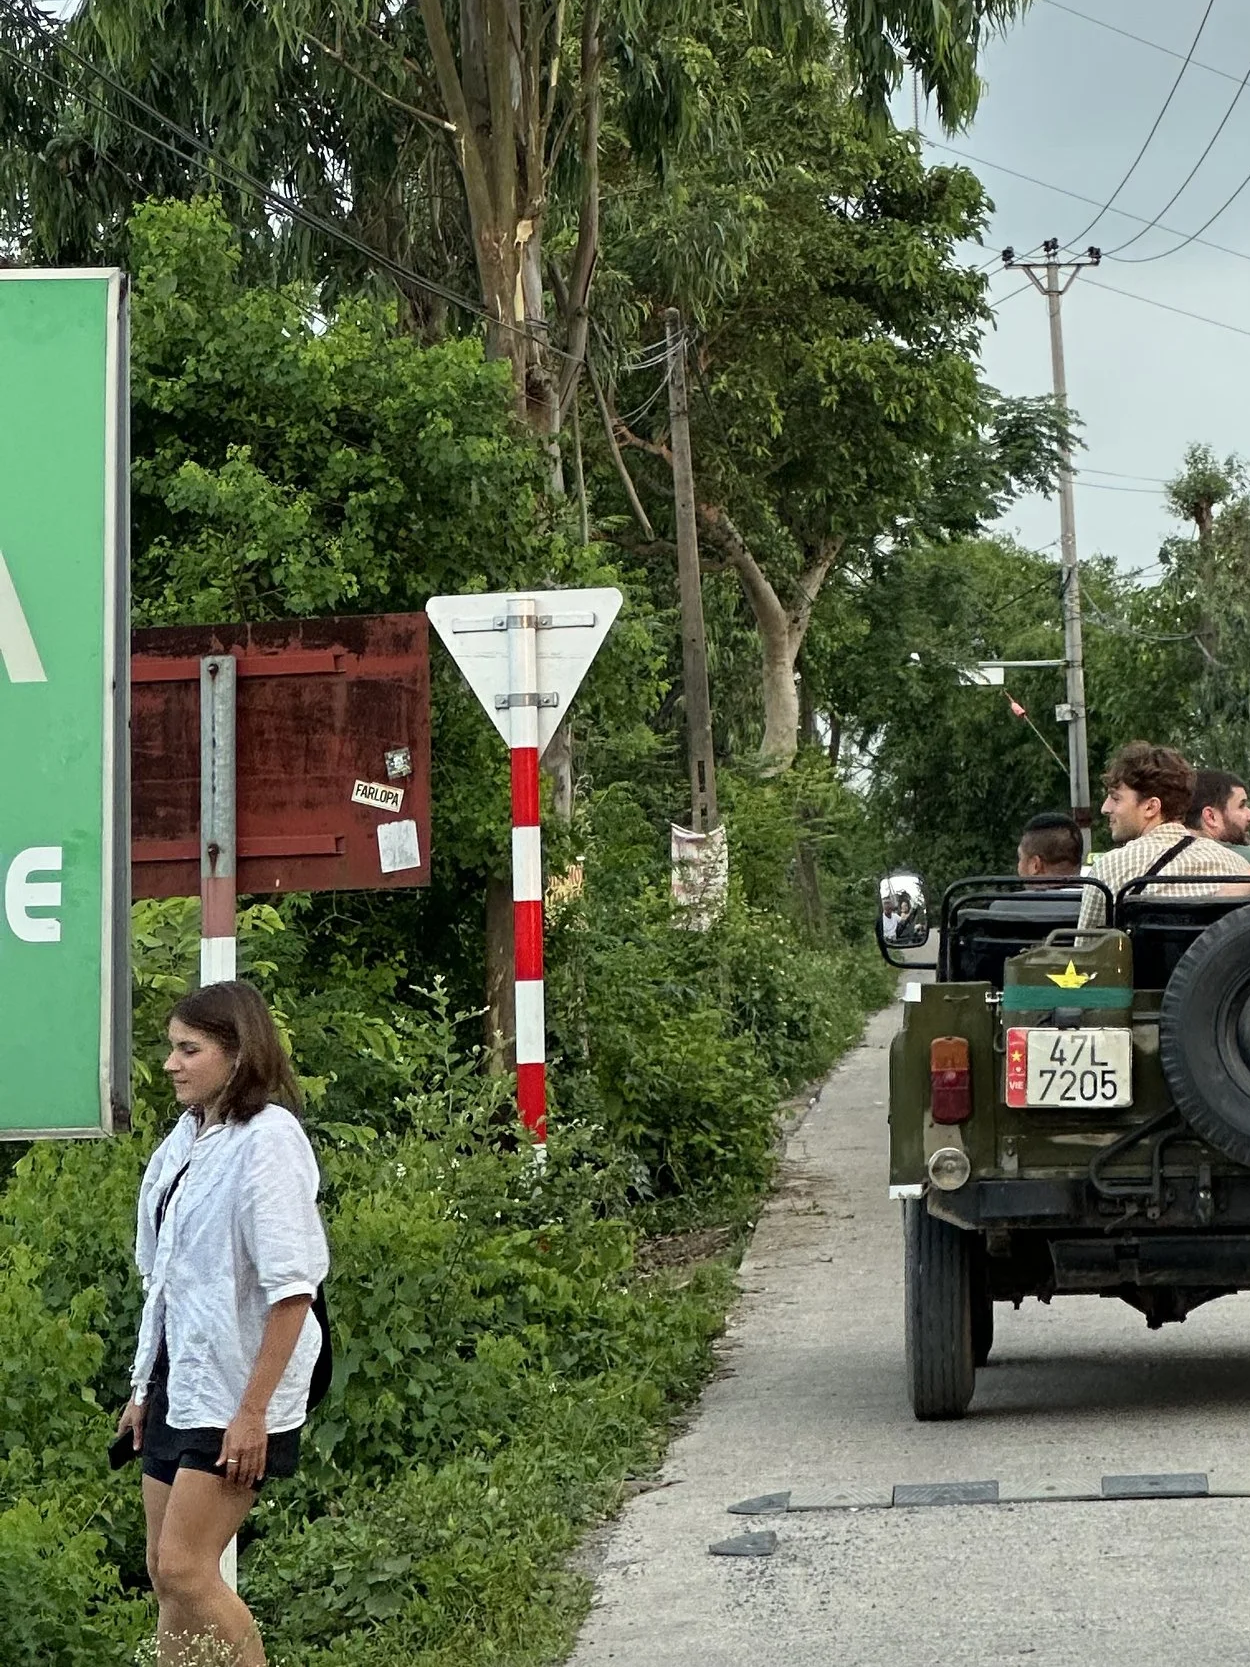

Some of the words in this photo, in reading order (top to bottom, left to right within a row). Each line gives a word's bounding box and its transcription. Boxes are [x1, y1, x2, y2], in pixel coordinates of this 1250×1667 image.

[355, 784, 399, 806] FARLOPA
[1050, 1035, 1108, 1066] 47L
[1009, 1081, 1024, 1090] VIE
[1039, 1070, 1117, 1101] 7205
